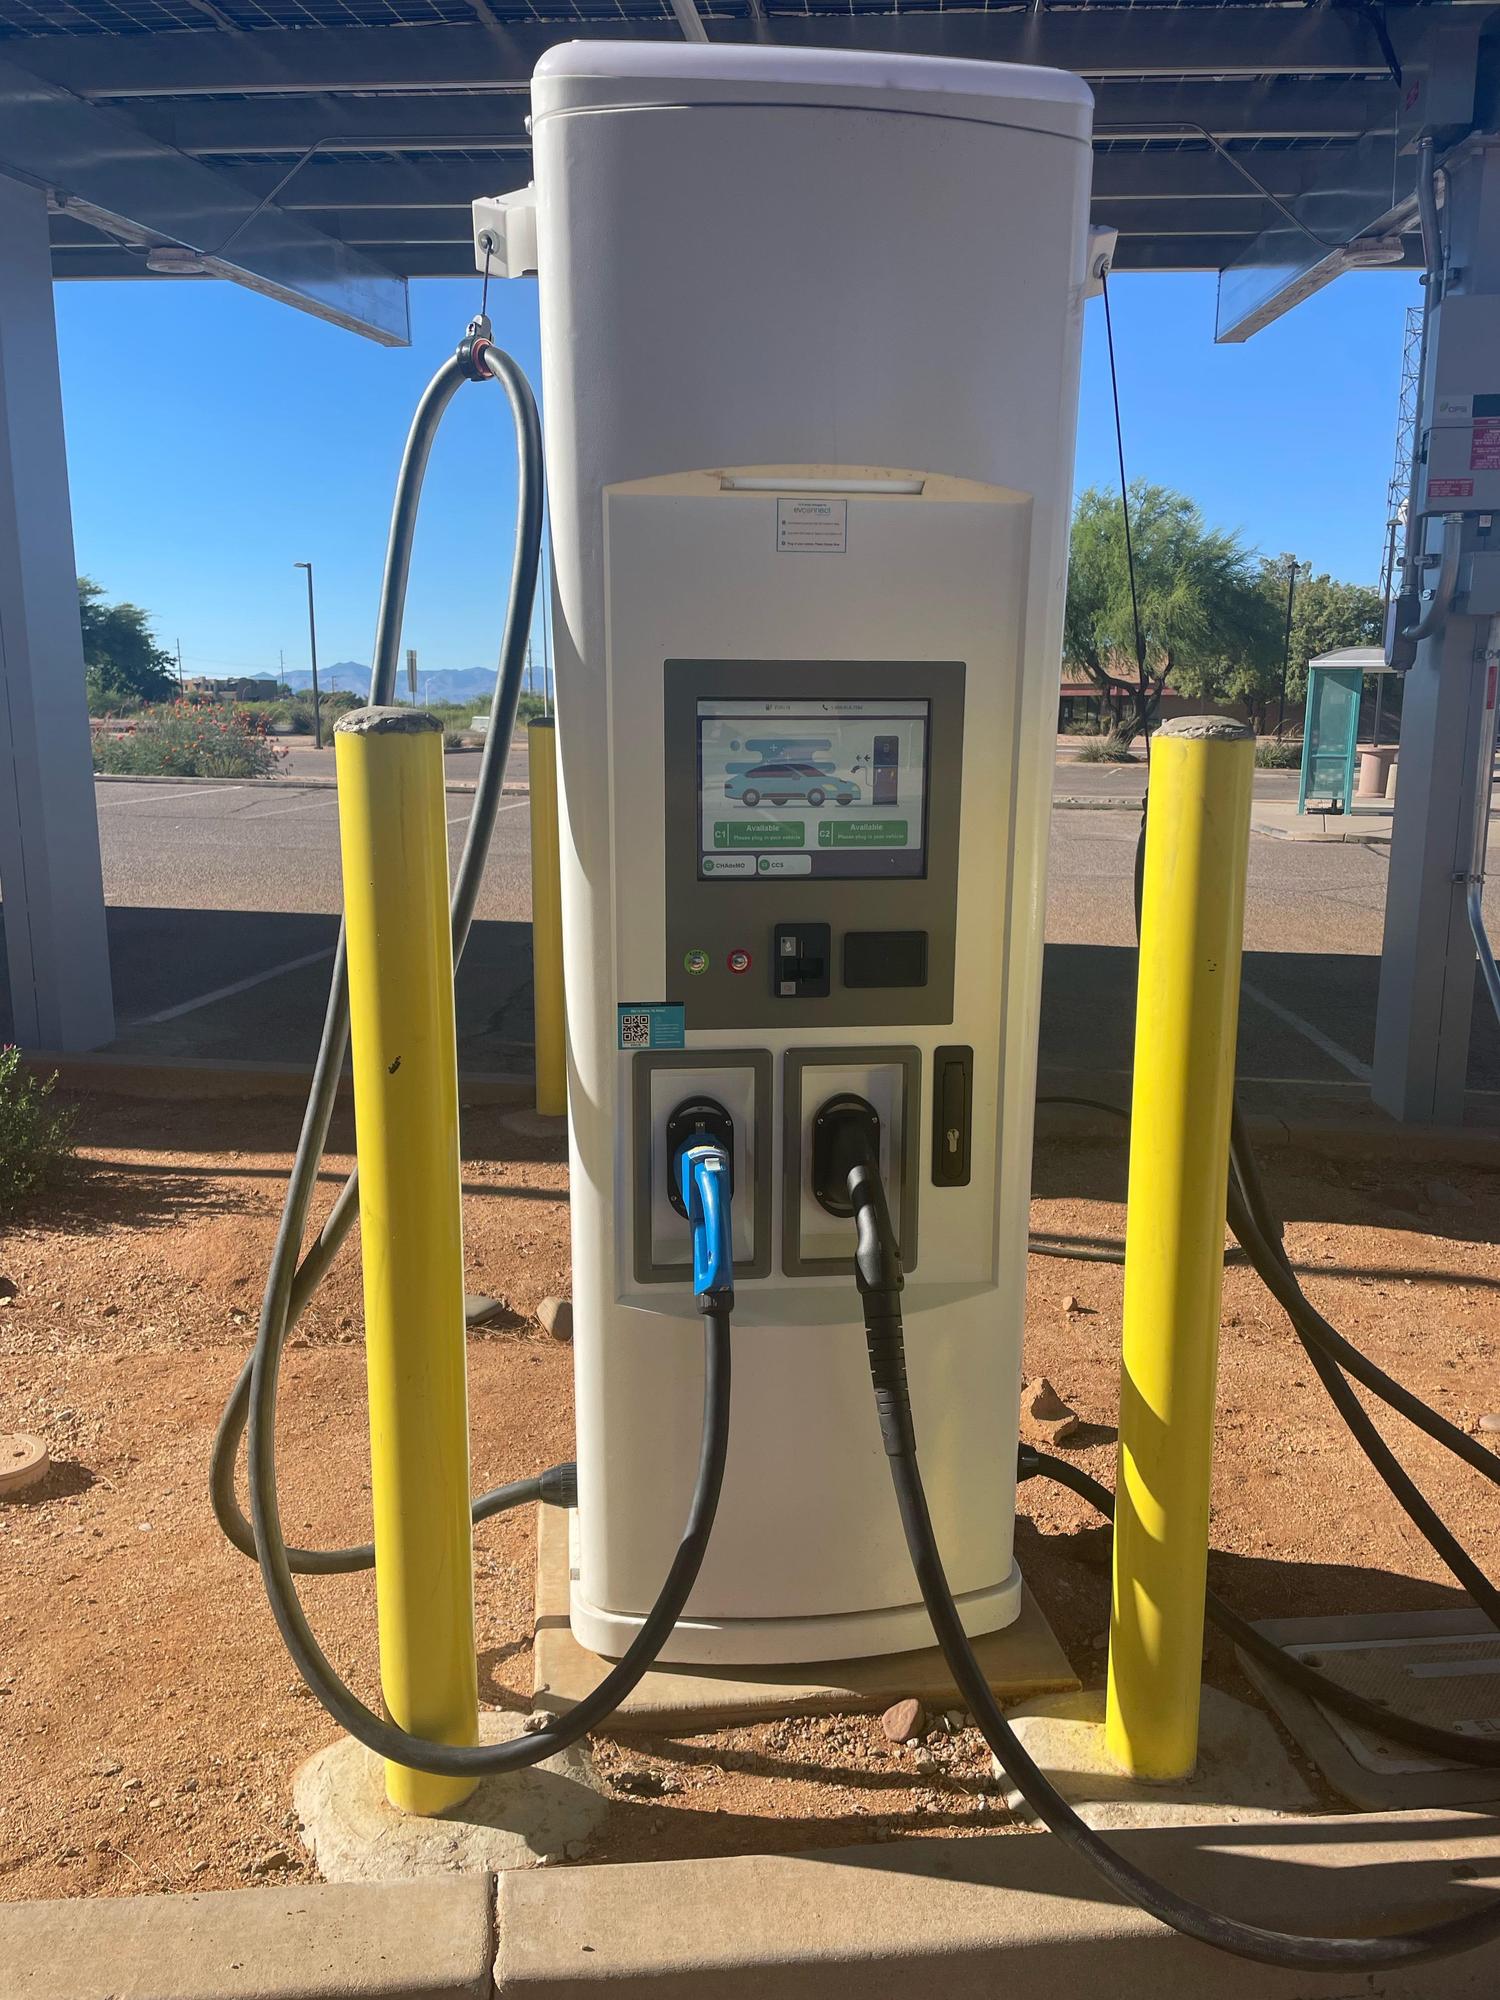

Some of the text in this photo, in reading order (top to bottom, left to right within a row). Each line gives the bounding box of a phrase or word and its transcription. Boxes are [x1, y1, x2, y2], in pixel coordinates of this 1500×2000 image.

[746, 824, 780, 833] Available
[850, 823, 883, 831] Available
[714, 830, 726, 838] C1
[819, 830, 830, 838] C2
